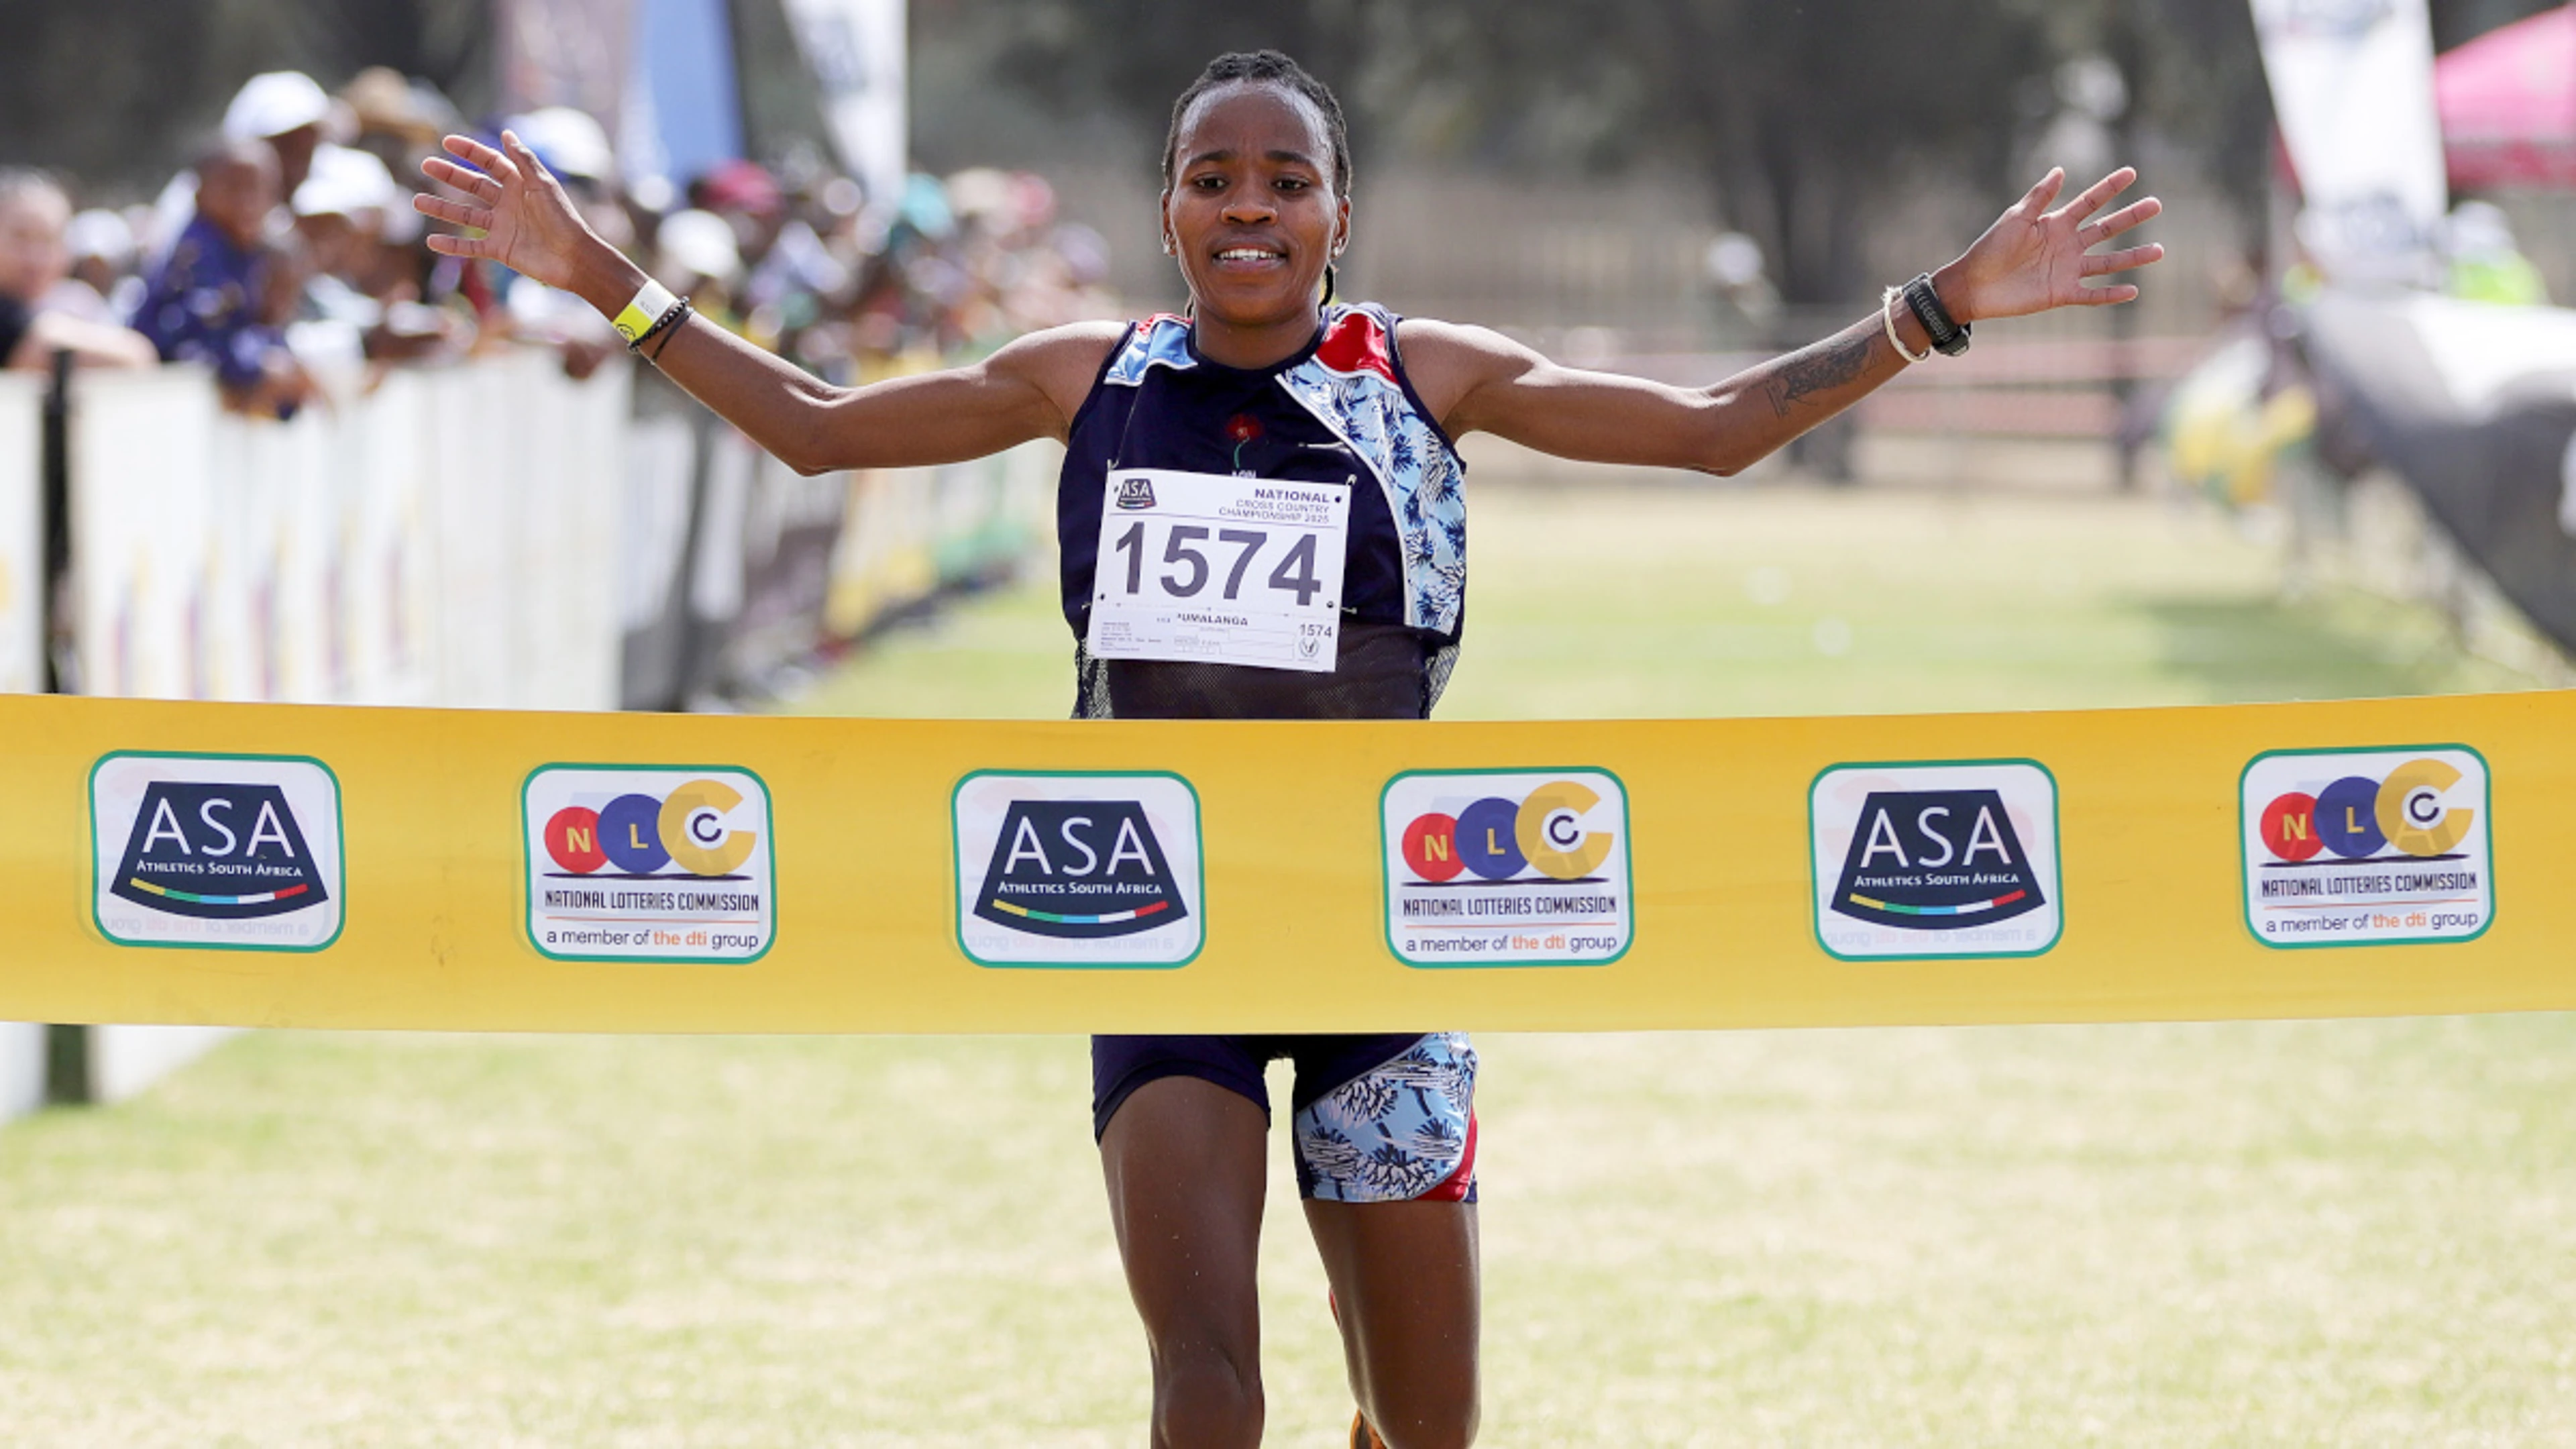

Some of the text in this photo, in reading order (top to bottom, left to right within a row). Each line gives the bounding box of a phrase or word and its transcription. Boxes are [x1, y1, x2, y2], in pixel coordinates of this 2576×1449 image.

[1122, 481, 1150, 496] ASA
[1255, 488, 1330, 503] NATIONAL
[1236, 499, 1330, 513] CROSS COUNTRY
[1116, 521, 1321, 606] 1574
[1299, 624, 1332, 637] 1574
[142, 796, 294, 857] ASA
[1860, 805, 2011, 867] ASA
[1004, 816, 1155, 876] ASA
[137, 859, 303, 877] ATHLETICS SOUTH AFRICA
[998, 881, 1162, 894] ATHLETICS SOUTH AFRICA
[1855, 872, 2019, 887] ATHLETICS SOUTH AFRICA
[2262, 872, 2477, 898] NATIONAL LOTTERIES COMMISSION
[545, 890, 759, 912] NATIONAL LOTTERIES COMMISSION
[1403, 897, 1616, 916] NATIONAL LOTTERIES COMMISSION
[2266, 912, 2478, 932] a member of the dti group
[547, 929, 758, 951] a member of the dti group
[1406, 934, 1617, 953] a member of the dti group
